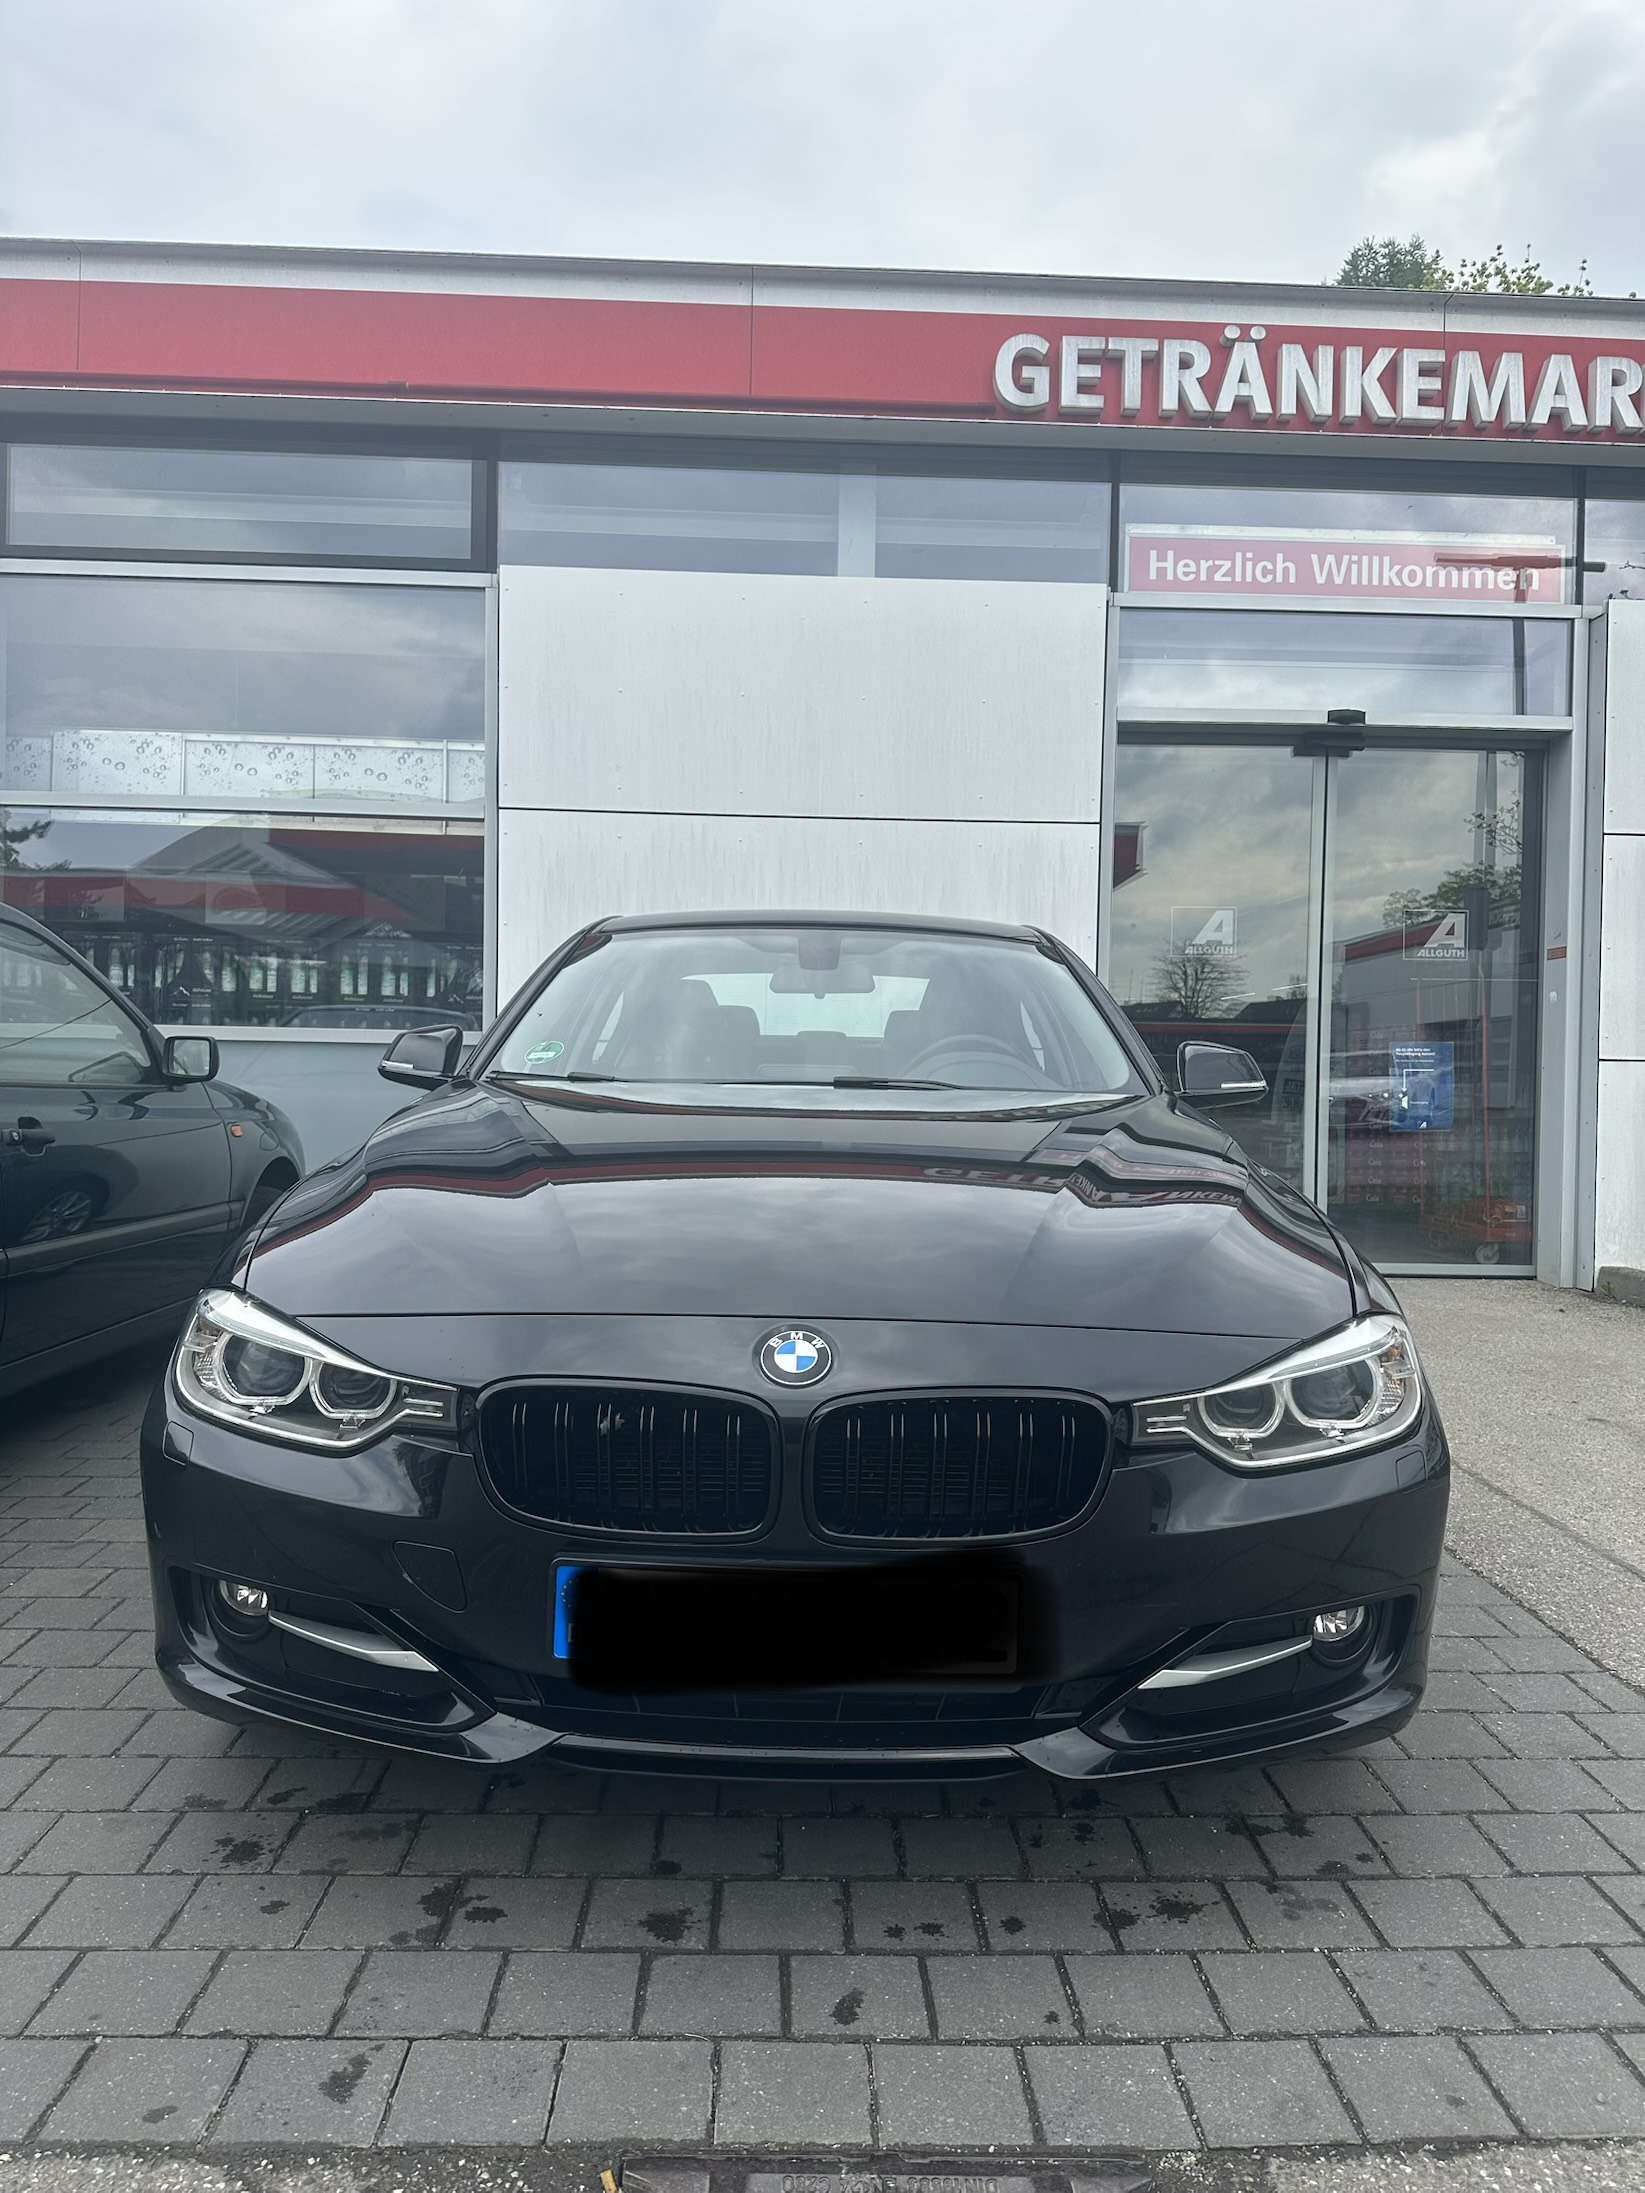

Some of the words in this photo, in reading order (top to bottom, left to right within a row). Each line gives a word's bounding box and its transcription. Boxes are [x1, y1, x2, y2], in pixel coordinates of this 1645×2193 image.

[993, 326, 1645, 432] GETRÄNKEMAR
[1150, 550, 1296, 584] Herzlich
[1311, 553, 1540, 590] Willkommen
[1424, 913, 1465, 947] A
[1417, 949, 1465, 957] ALLGUTH
[769, 1332, 825, 1348] BMW
